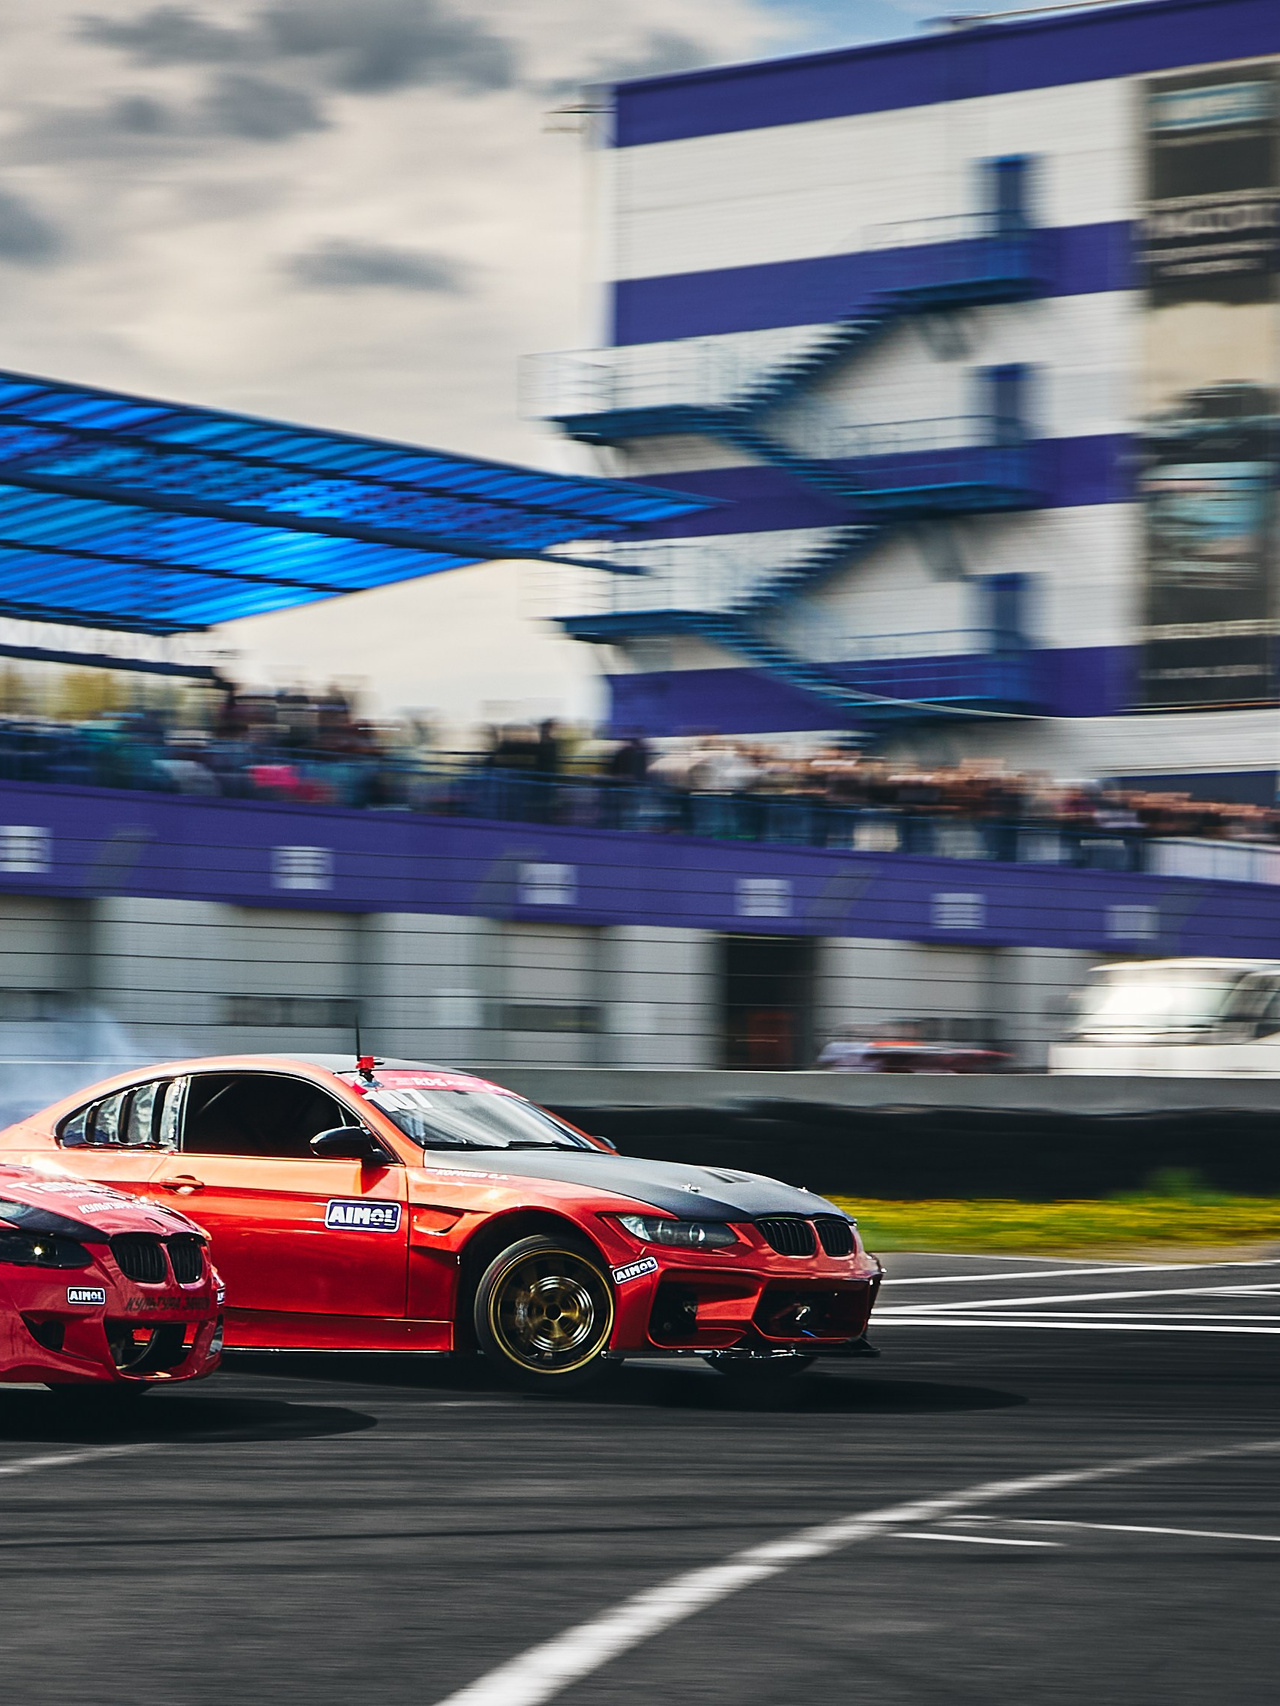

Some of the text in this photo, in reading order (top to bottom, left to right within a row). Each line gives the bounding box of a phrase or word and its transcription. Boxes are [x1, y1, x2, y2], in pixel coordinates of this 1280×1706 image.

[361, 1088, 433, 1113] 107
[328, 1205, 397, 1228] AIMOL
[615, 1260, 656, 1282] AIMOL
[69, 1290, 104, 1302] AIMOL
